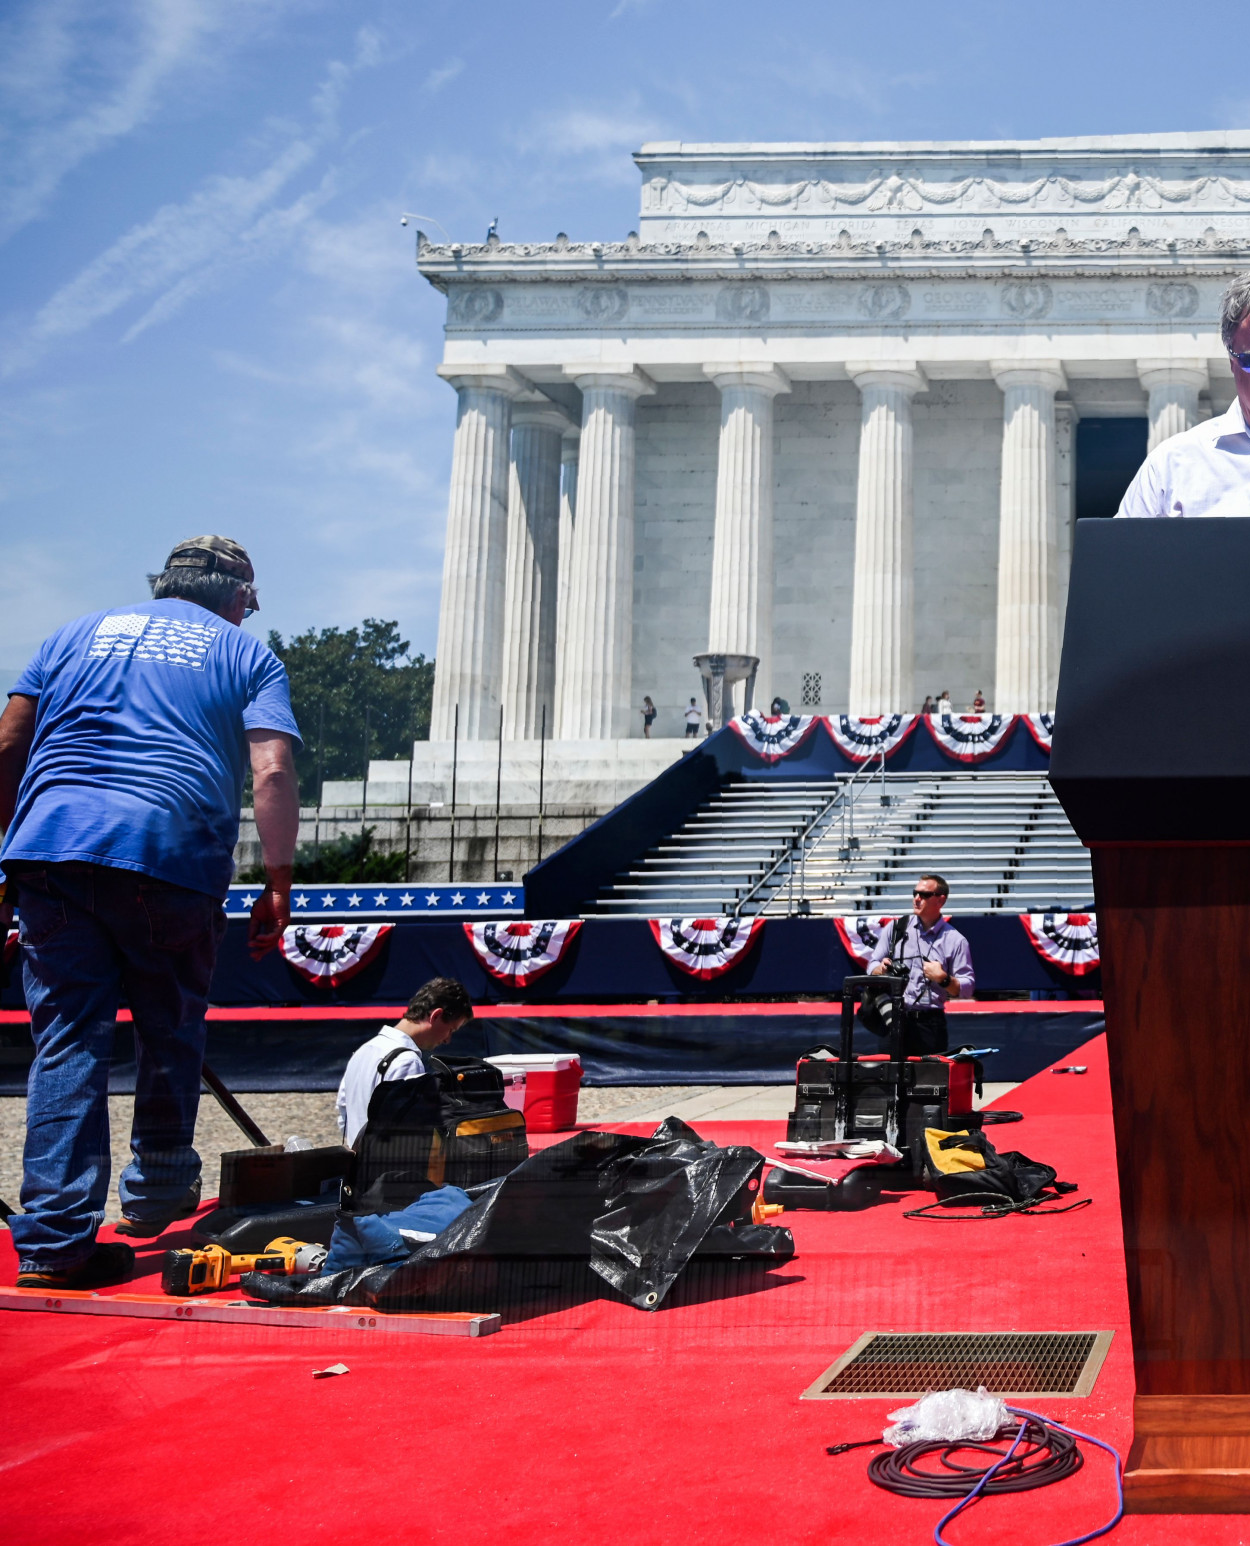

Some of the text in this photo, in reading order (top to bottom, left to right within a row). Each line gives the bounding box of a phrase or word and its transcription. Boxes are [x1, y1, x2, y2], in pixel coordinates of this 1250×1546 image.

[664, 221, 732, 232] ARKANSAS
[745, 220, 810, 231] MICHIGAN
[824, 220, 878, 231] FLORIDA
[896, 220, 935, 230] TEXAS
[953, 220, 988, 229] IOWA
[1006, 218, 1080, 229] WISCONSIN
[1094, 218, 1169, 228] CALIFORNIA
[923, 291, 990, 304] GEORGIA
